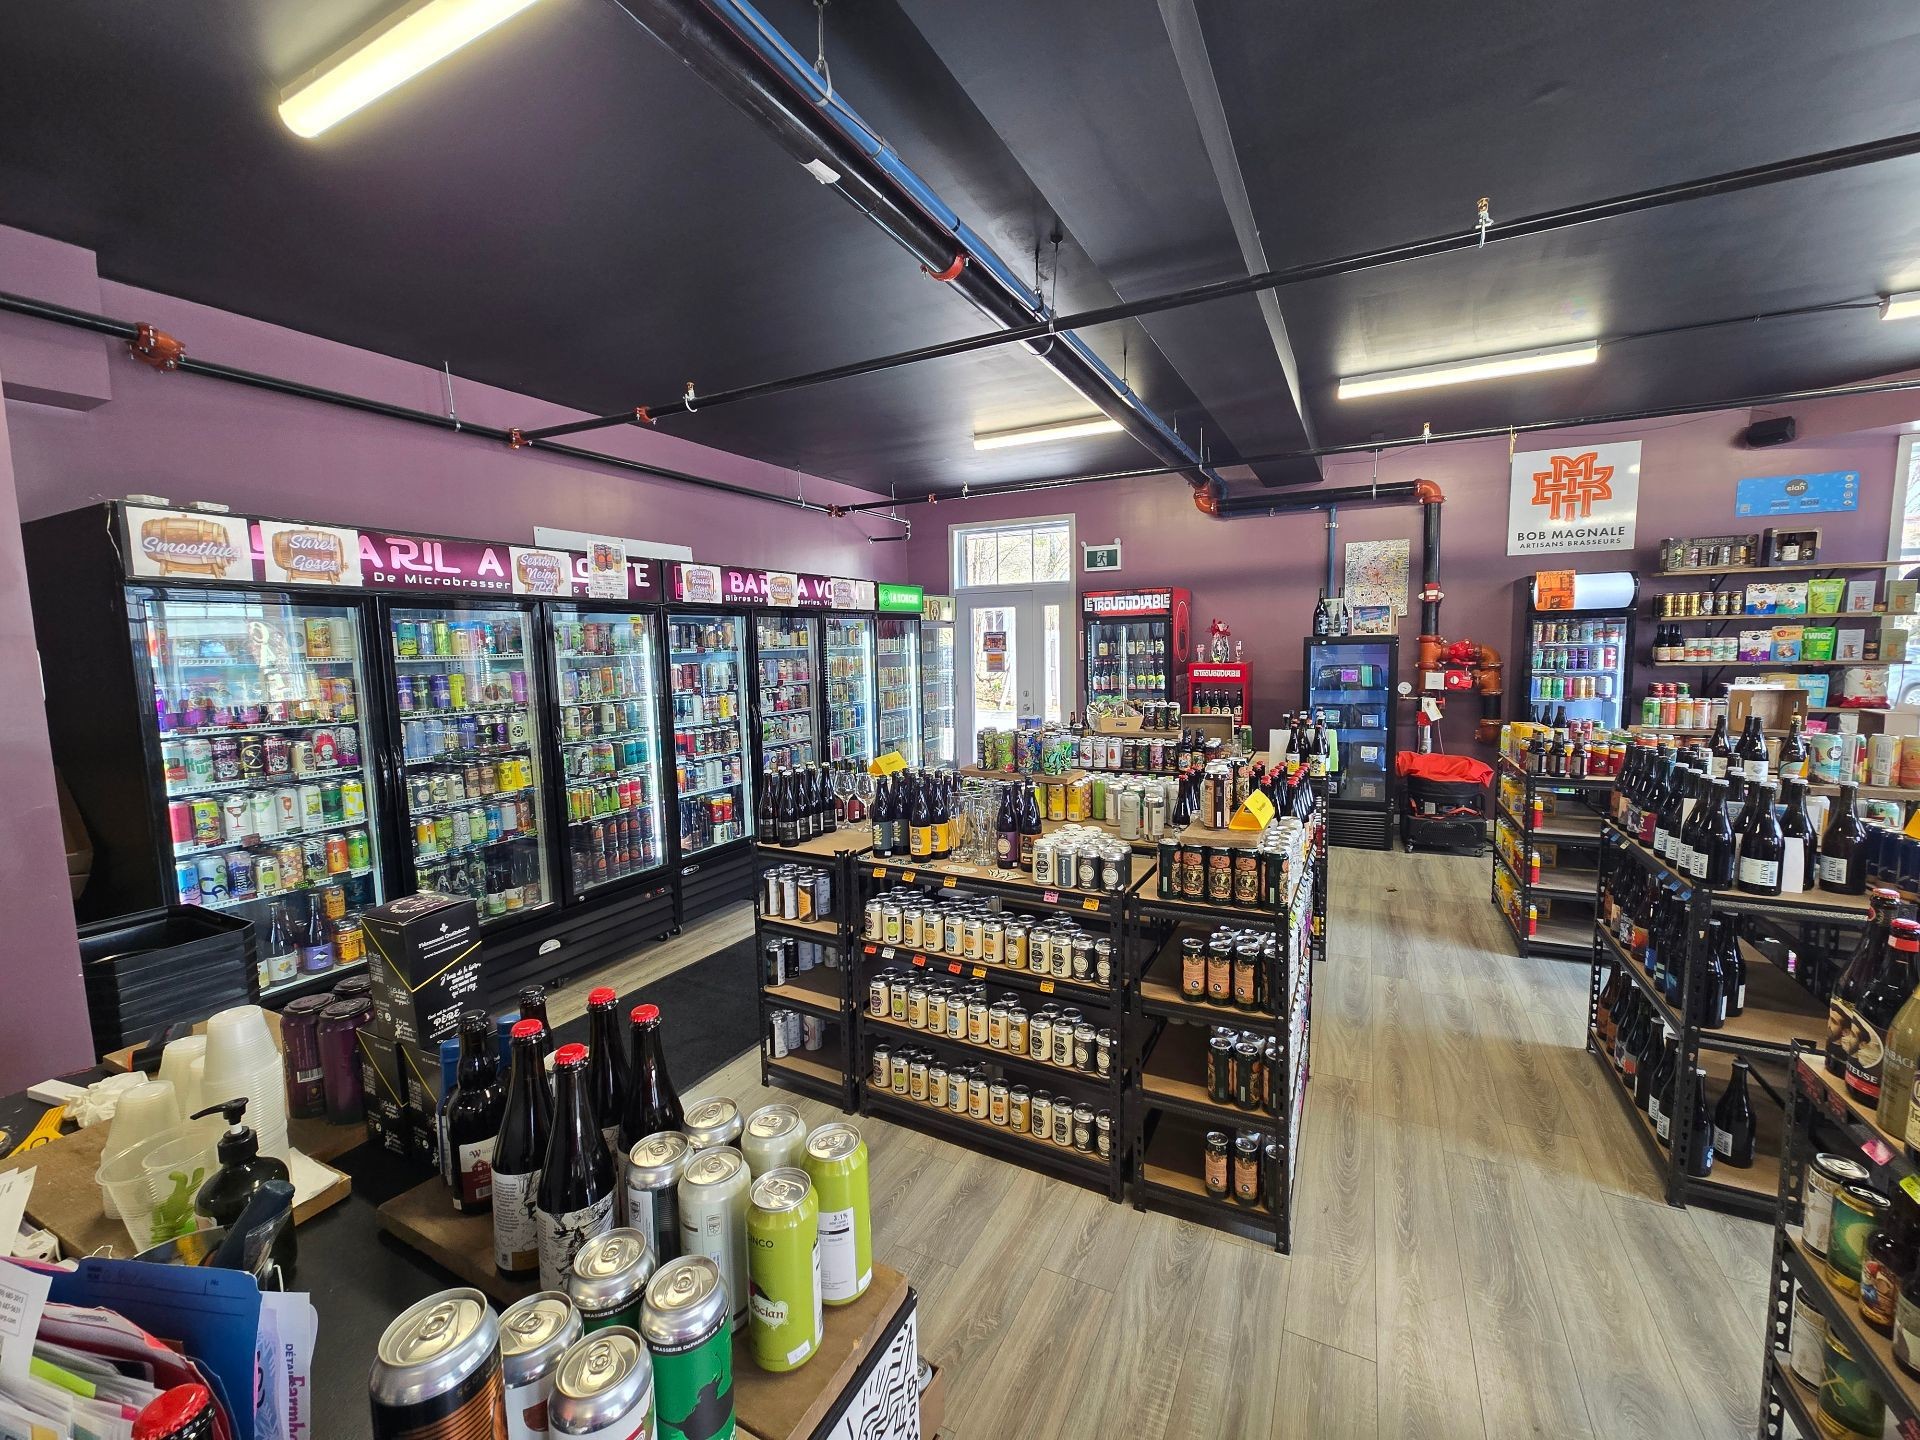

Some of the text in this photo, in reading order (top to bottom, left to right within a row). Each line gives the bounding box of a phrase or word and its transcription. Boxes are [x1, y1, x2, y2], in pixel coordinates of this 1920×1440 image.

[1517, 526, 1625, 542] BOB MAGNALE
[1519, 538, 1621, 549] ARTISANS BRASSEURS
[292, 555, 338, 572] Goses
[477, 548, 504, 577] A
[374, 572, 397, 583] De
[725, 594, 751, 603] Bières
[1804, 632, 1832, 640] TWIGZ
[433, 1008, 461, 1026] PÈRE
[1846, 1062, 1878, 1084] TEUSE
[652, 1345, 683, 1353] BRASSERIE
